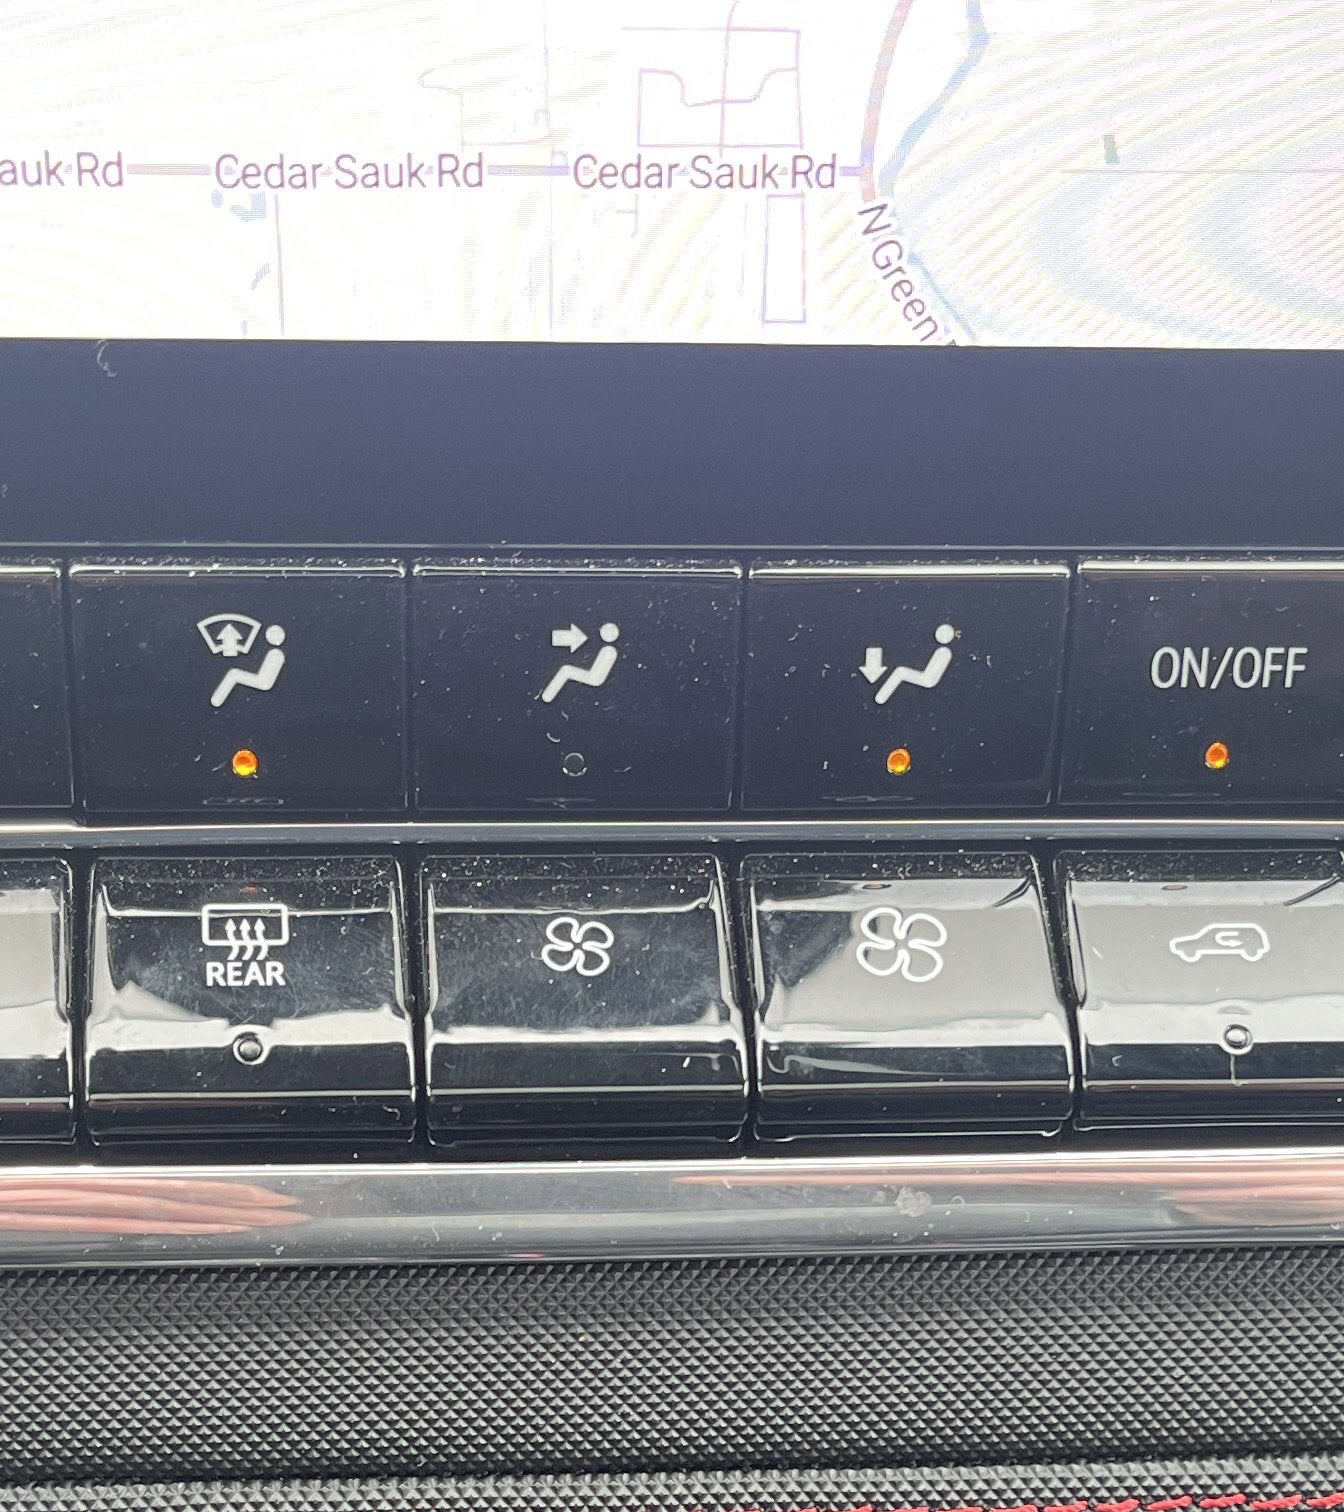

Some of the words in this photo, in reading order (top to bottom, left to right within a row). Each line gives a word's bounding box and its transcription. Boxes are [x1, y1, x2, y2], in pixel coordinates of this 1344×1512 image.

[76, 150, 125, 188] Rd
[214, 152, 323, 190] Cedar
[333, 153, 426, 190] Sauk
[436, 152, 485, 189] Rd
[572, 153, 679, 190] Cedar
[689, 153, 780, 190] Sauk
[791, 153, 838, 190] Rd
[857, 203, 893, 236] N
[871, 239, 939, 343] Green
[1149, 645, 1309, 692] ON/OFF
[204, 961, 287, 988] REAR
